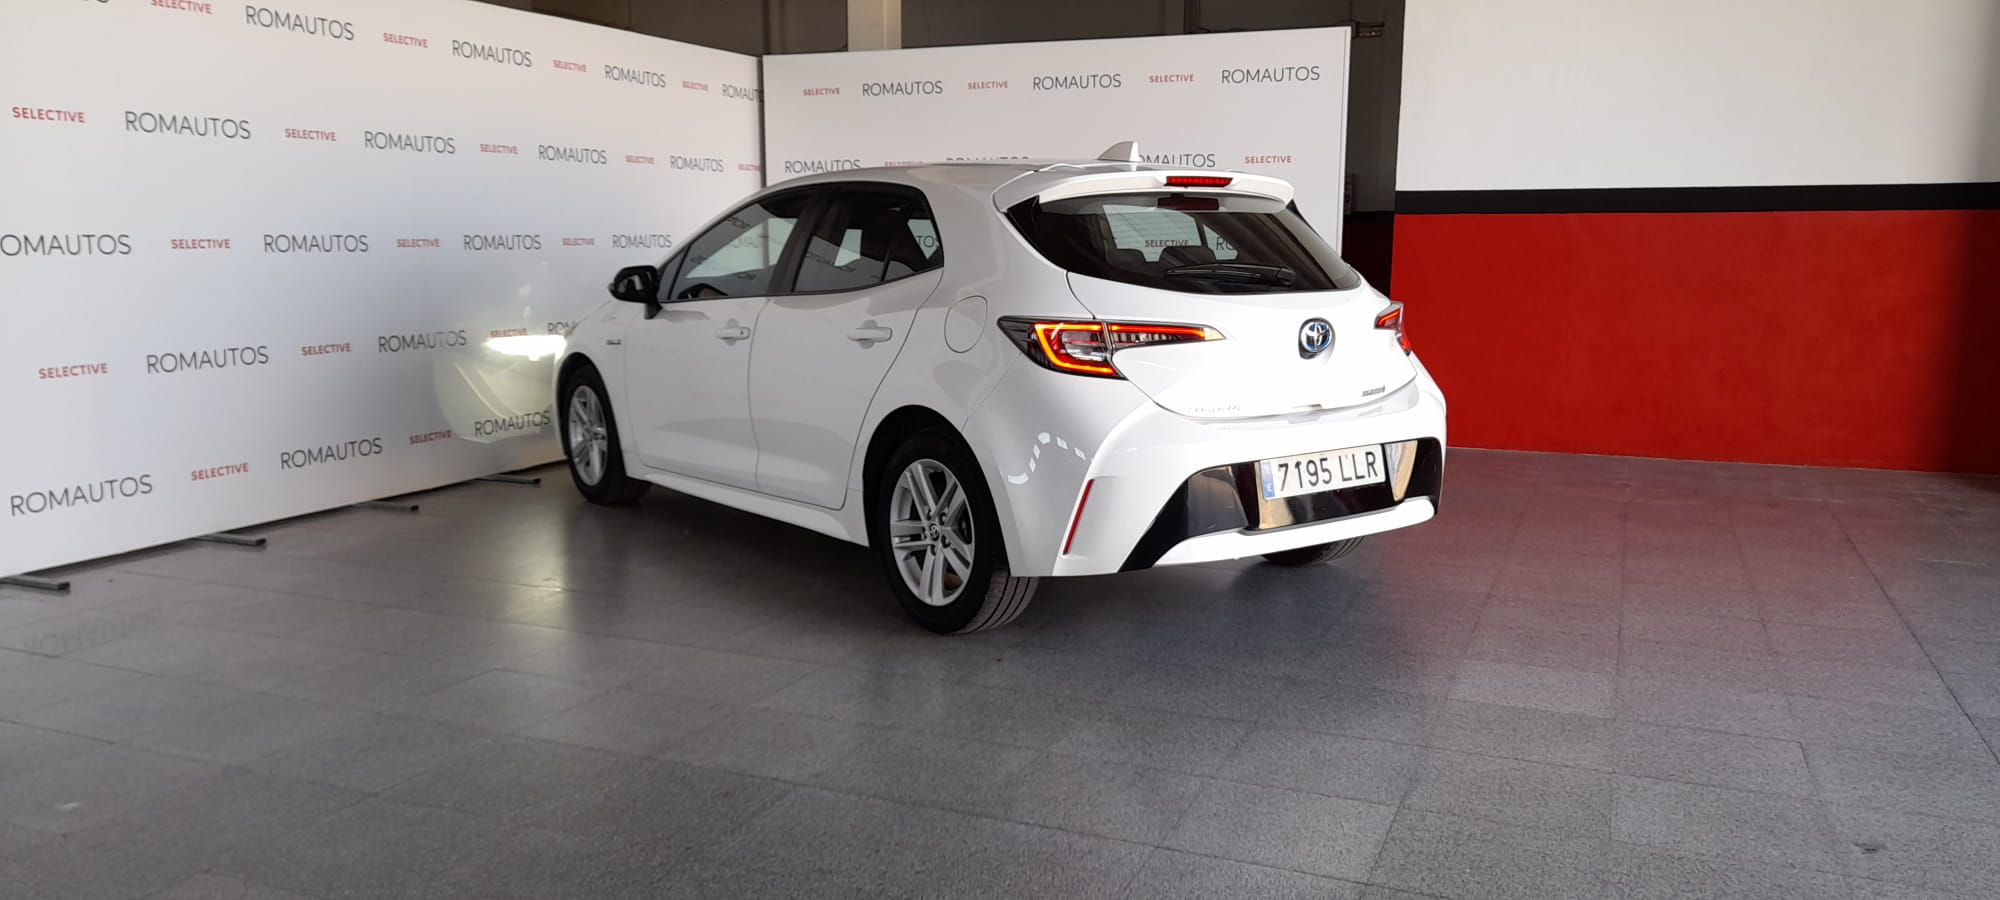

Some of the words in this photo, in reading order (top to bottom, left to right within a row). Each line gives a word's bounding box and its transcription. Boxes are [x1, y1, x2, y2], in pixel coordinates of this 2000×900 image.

[150, 0, 211, 14] SELECTIVE
[245, 5, 354, 40] ROMAUTOS
[383, 33, 428, 48] SELECTIVE
[452, 40, 532, 67] ROMAUTOS
[604, 65, 666, 88] ROMAUTOS
[862, 80, 943, 96] ROMAUTOS
[968, 81, 1008, 90] SELECTIVE
[1033, 74, 1121, 90] ROMAUTOS
[1149, 74, 1194, 83] SELECTIVE
[1222, 66, 1320, 84] ROMAUTOS
[12, 107, 84, 123] SELECTIVE
[125, 111, 251, 139] ROMAUTOS
[285, 128, 336, 141] SELECTIVE
[364, 131, 456, 154] ROMAUTOS
[538, 145, 607, 164] ROMAUTOS
[670, 155, 724, 173] ROMAUTOS
[785, 159, 860, 173] ROMAUTOS
[1138, 153, 1216, 168] MAUTOS
[1245, 156, 1292, 164] SELECTIVE
[0, 234, 131, 256] OMAUTOS
[171, 239, 230, 249] SELECTIVE
[264, 234, 368, 253] ROMAUTOS
[396, 239, 440, 248] SELECTIVE
[464, 235, 541, 251] ROMAUTOS
[612, 234, 672, 249] ROMAUTOS
[38, 363, 108, 379] SELECTIVE
[147, 346, 269, 374] ROMAUTOS
[301, 343, 351, 356] SELECTIVE
[378, 330, 467, 352] ROMAUTOS
[10, 474, 152, 516] ROMAUTOS
[191, 463, 248, 481] SELECTIVE
[281, 437, 382, 470] ROMAUTOS
[409, 429, 452, 445] SELECTIVE
[474, 410, 551, 437] ROMAUTOS
[1278, 458, 1332, 491] 7195
